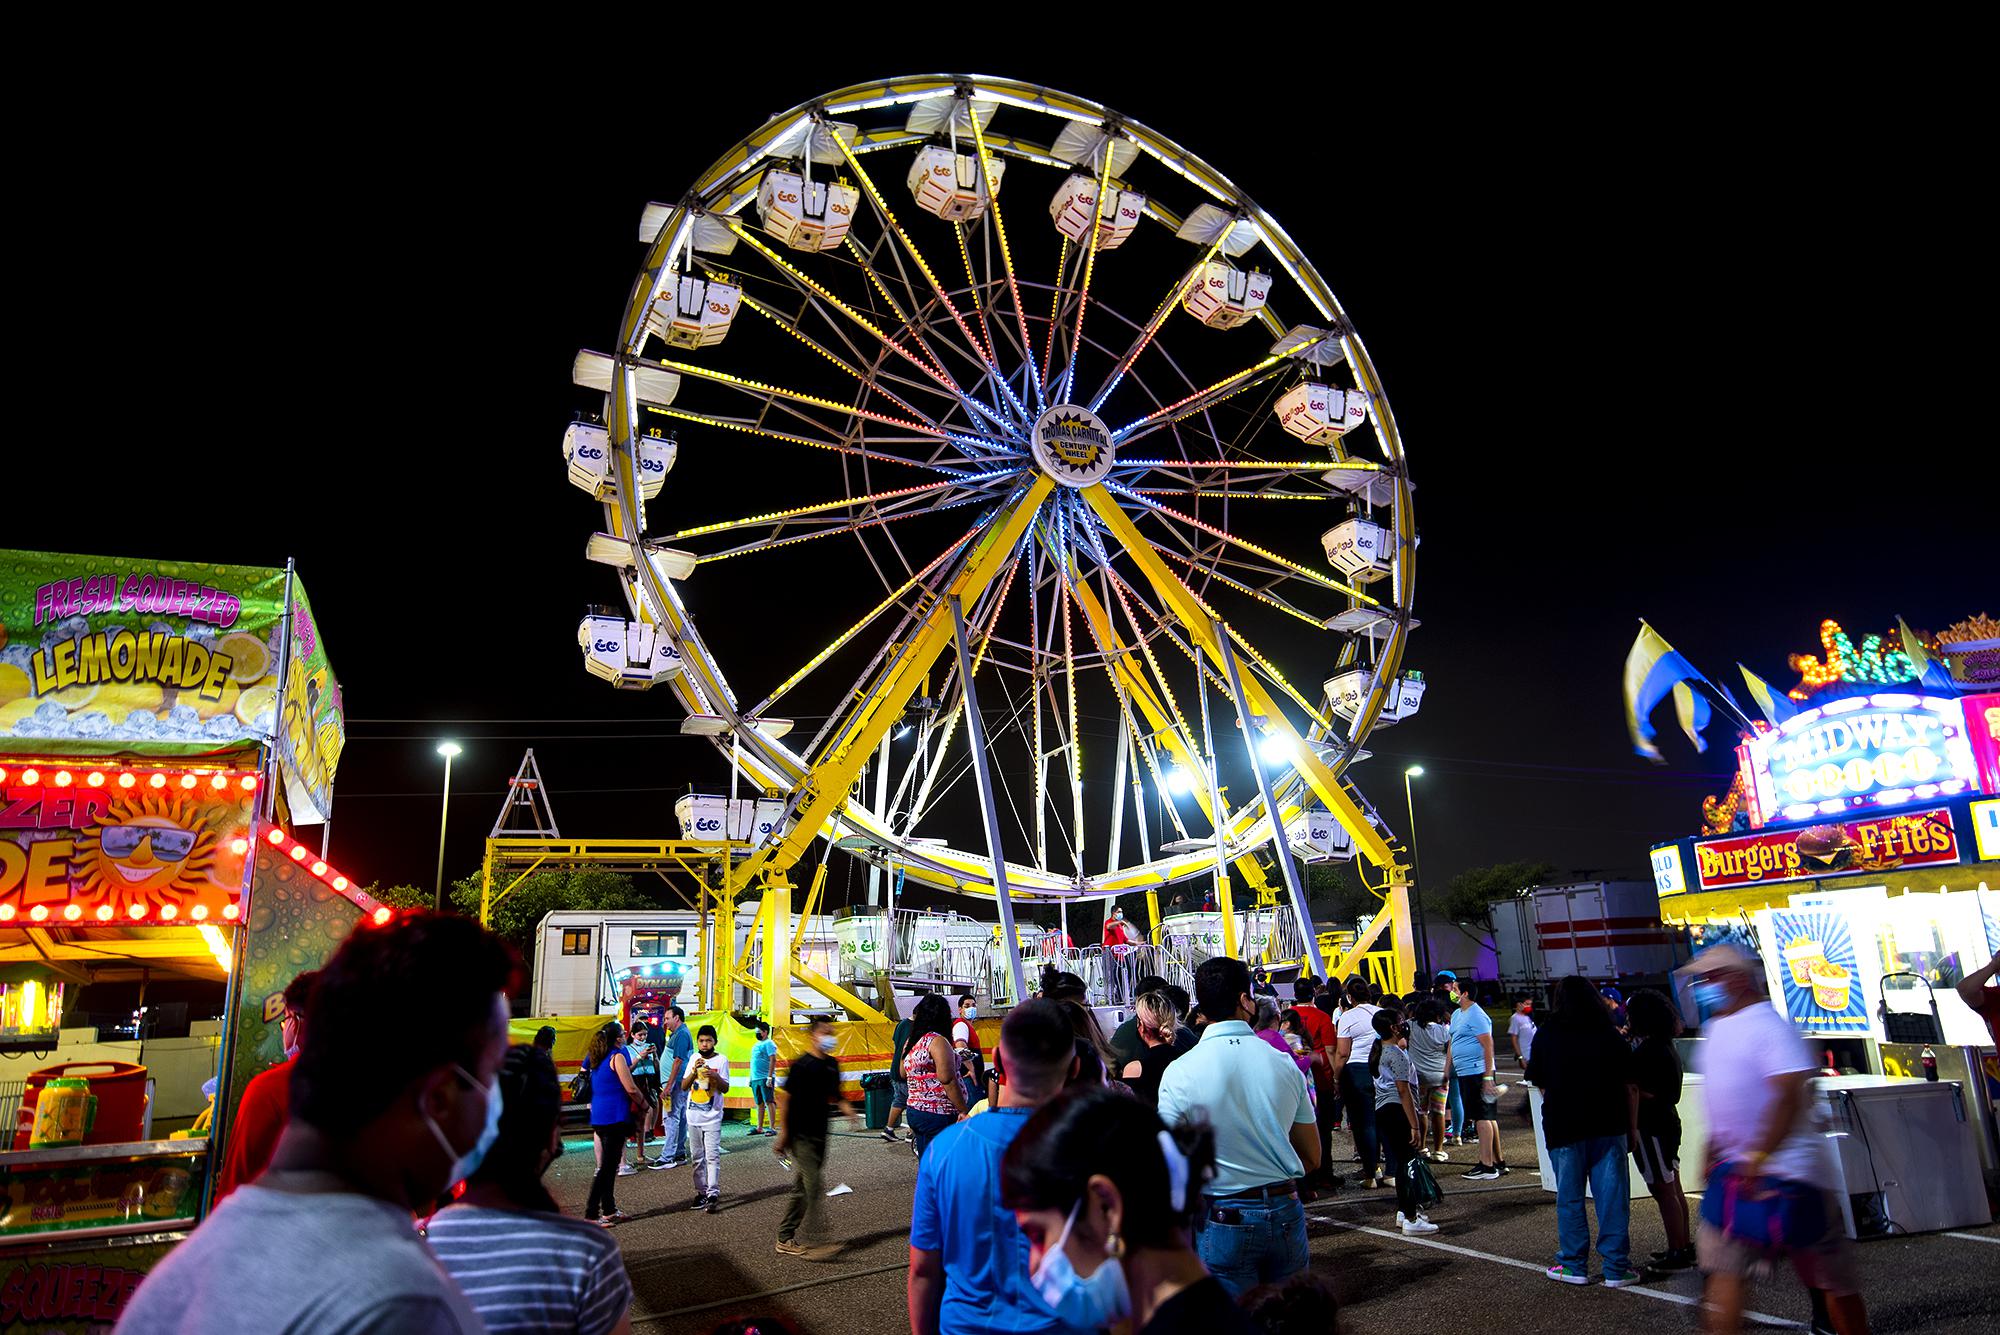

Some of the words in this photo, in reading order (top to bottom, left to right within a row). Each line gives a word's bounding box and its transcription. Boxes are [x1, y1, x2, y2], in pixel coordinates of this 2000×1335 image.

[649, 427, 662, 438] 13
[1041, 424, 1071, 440] THOMAS
[1071, 425, 1109, 448] CARNIVAL
[1060, 440, 1091, 451] CENTURY
[1064, 449, 1089, 459] WHEEL
[34, 574, 118, 626] FRESH
[119, 573, 242, 628] SQUEEZED
[31, 630, 234, 701] LEMONADE
[1773, 712, 1939, 773] MIDWAY
[767, 788, 778, 798] 15
[1857, 821, 1951, 860] Fries
[1697, 841, 1801, 881] Burgers
